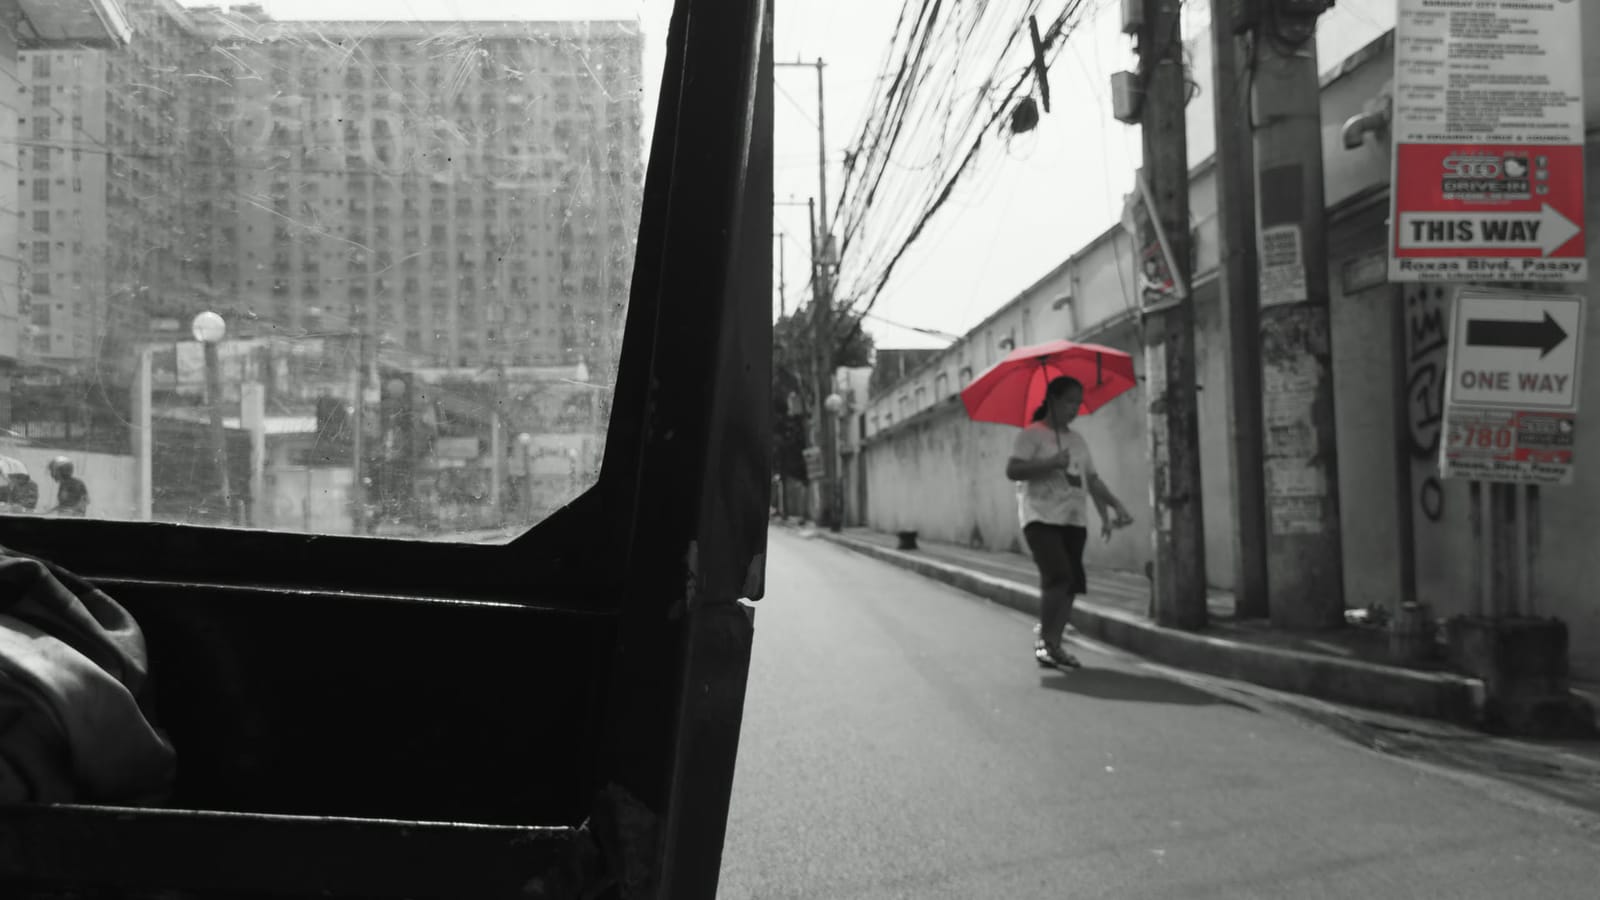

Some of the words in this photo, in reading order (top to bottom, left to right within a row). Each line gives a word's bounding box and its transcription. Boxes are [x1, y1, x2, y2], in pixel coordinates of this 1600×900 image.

[1410, 220, 1473, 241] THIS
[1480, 220, 1541, 241] WAY
[1400, 258, 1460, 271] Roxas
[1522, 258, 1582, 273] Pasay
[1460, 370, 1511, 391] ONE
[1518, 372, 1569, 393] WAY
